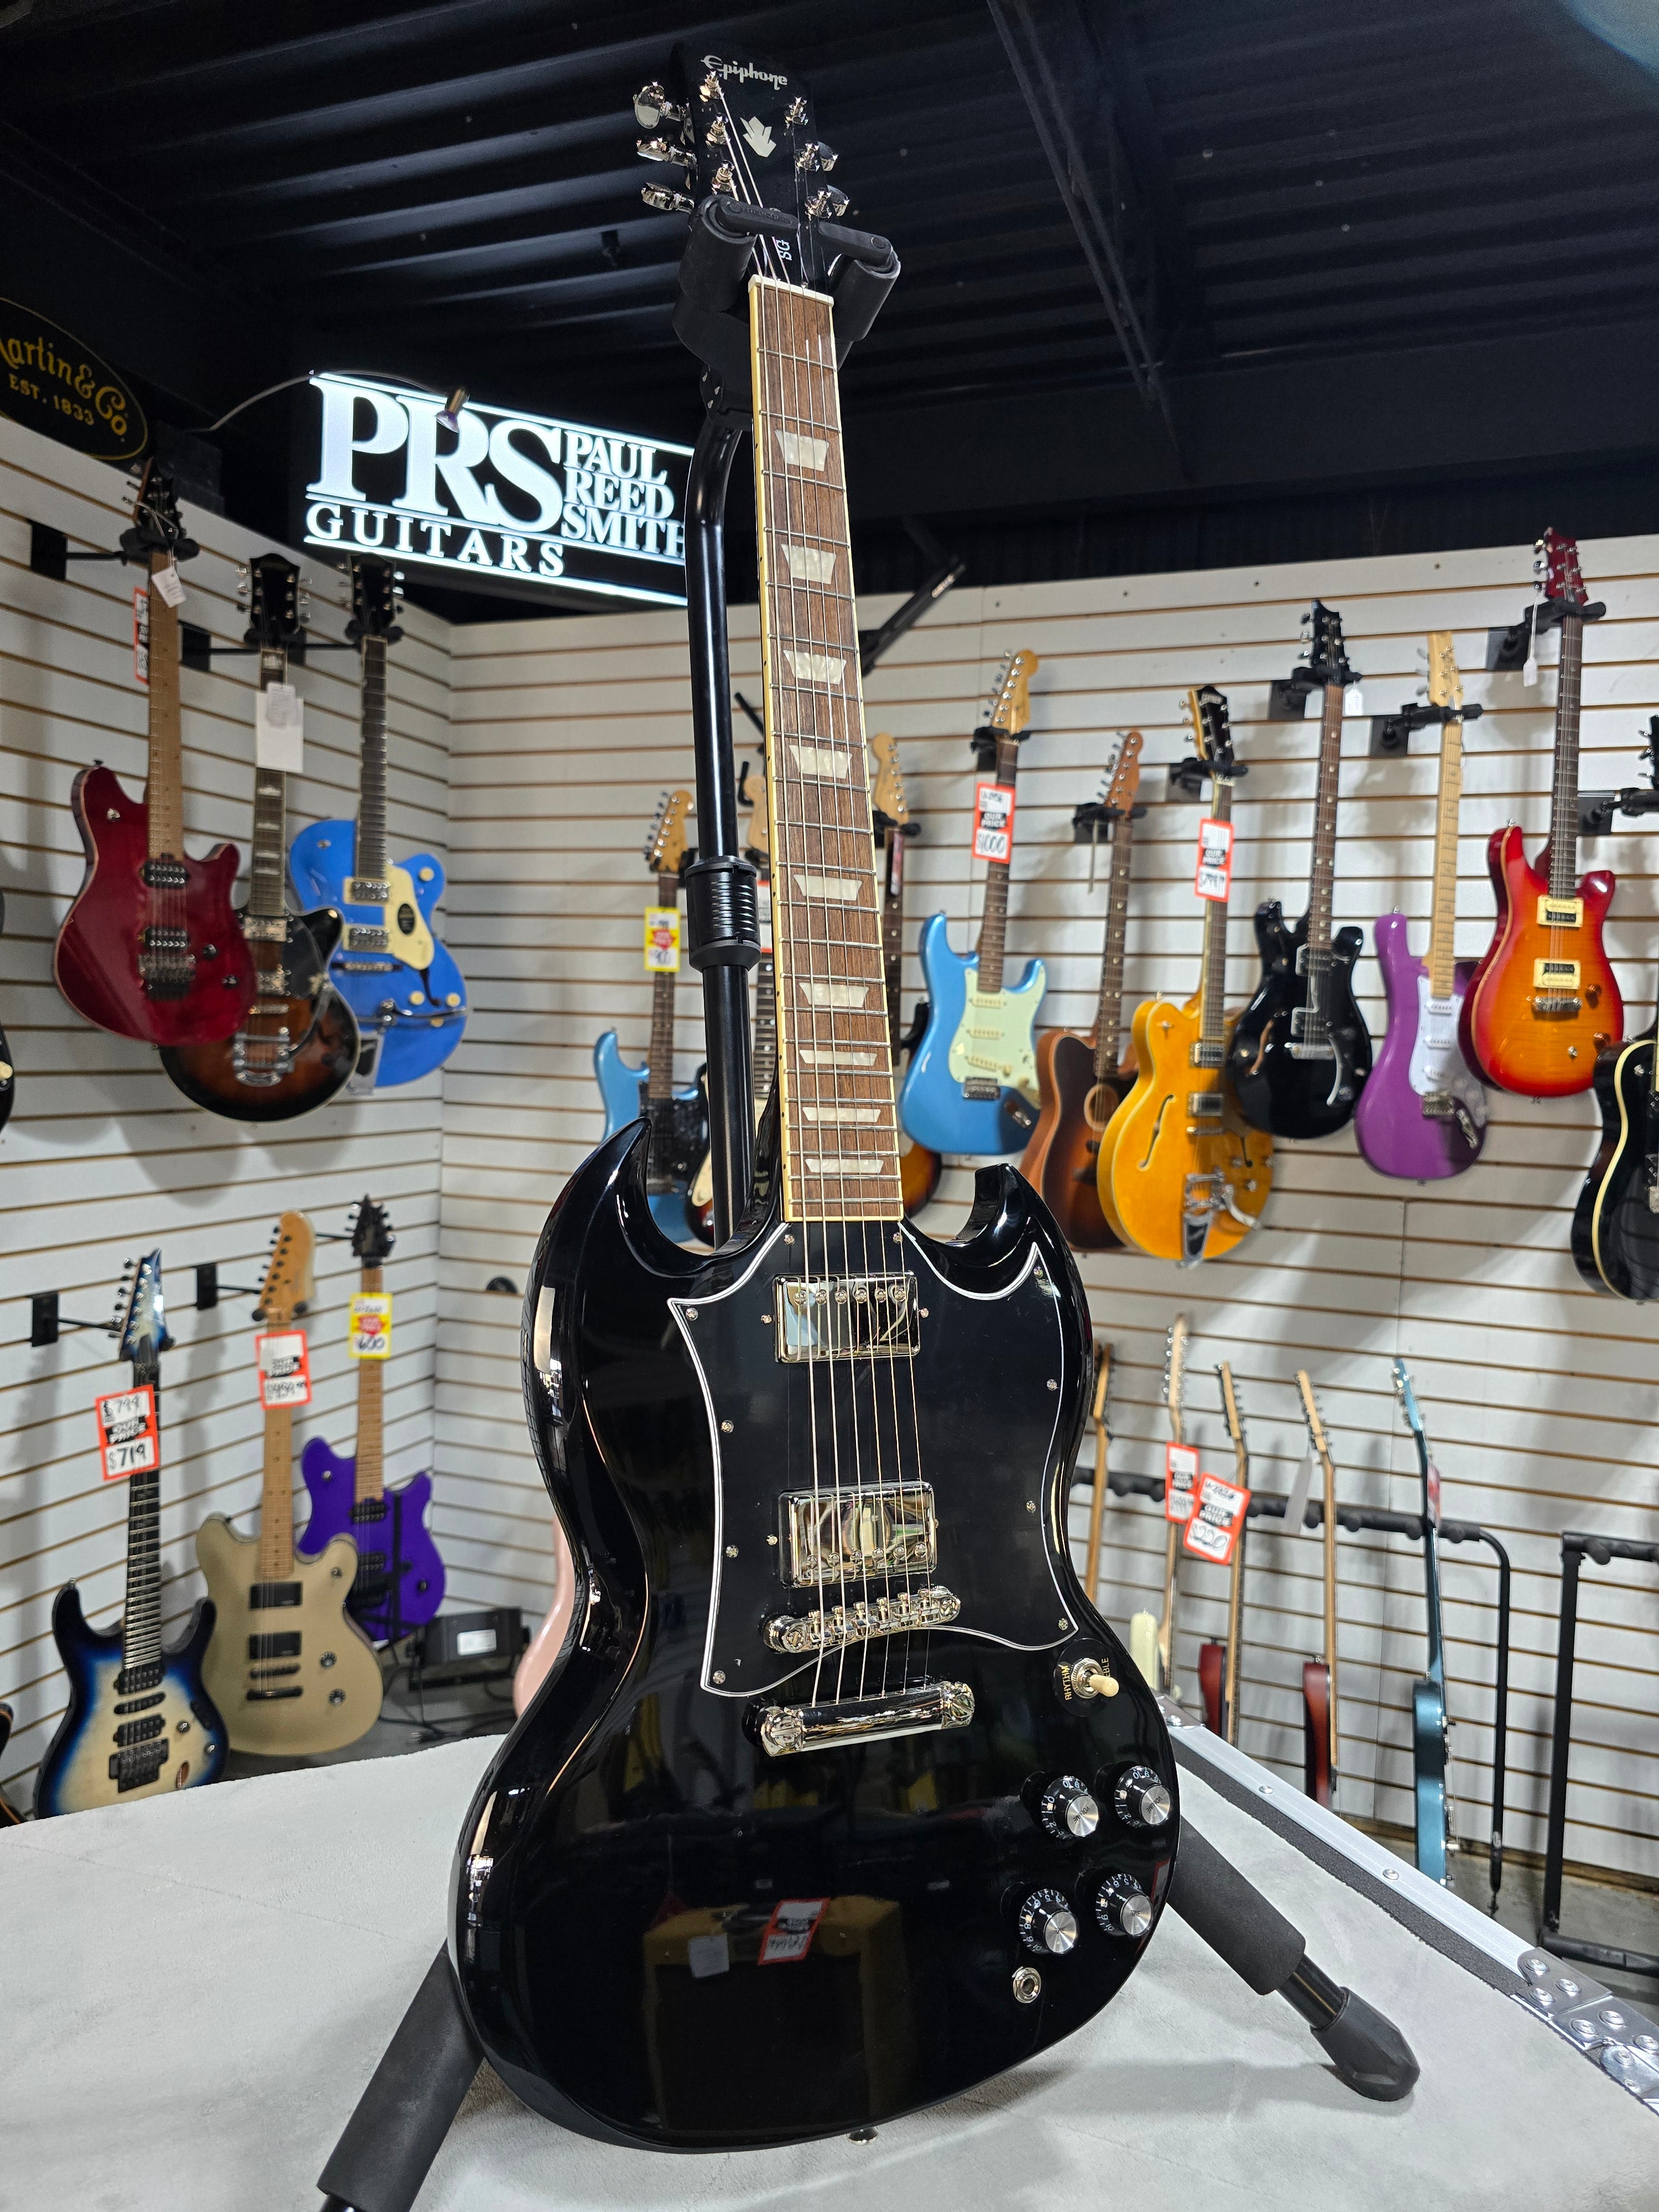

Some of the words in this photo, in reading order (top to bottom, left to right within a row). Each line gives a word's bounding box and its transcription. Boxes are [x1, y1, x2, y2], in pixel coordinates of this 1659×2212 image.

[700, 55, 787, 91] Epiphone
[776, 239, 792, 261] SG
[53, 394, 95, 426] 1833
[307, 377, 563, 533] PRS
[563, 430, 667, 486] PAUL
[563, 466, 675, 520] REED
[306, 502, 564, 577] GUITARS
[109, 1444, 147, 1469] $719
[1058, 1664, 1072, 1700] RHYTHM
[1101, 1657, 1110, 1677] EBLE
[1073, 1806, 1091, 1824] VOLUME
[1146, 1796, 1163, 1814] VOLUME
